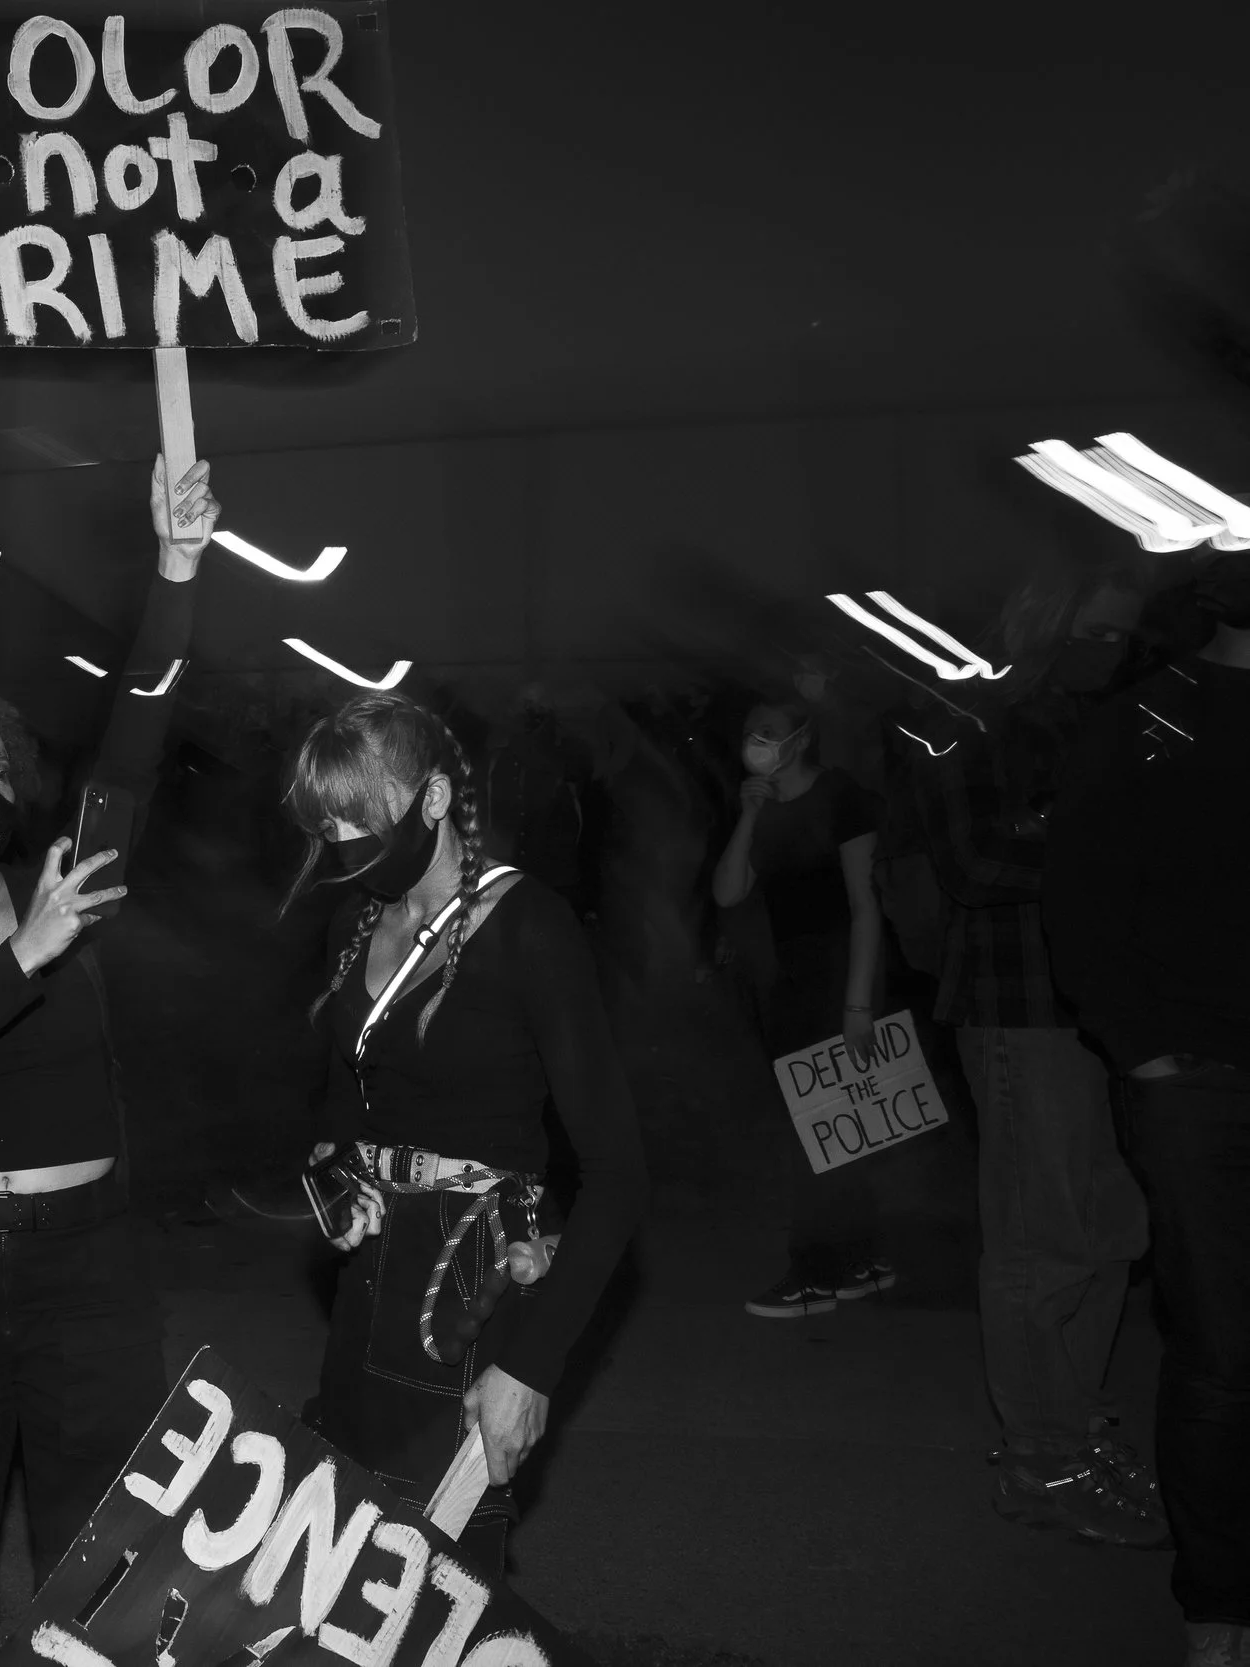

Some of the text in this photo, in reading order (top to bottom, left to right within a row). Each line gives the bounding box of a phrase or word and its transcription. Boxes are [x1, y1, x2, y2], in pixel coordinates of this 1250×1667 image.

[19, 112, 219, 221] not
[273, 149, 366, 236] a
[811, 1082, 939, 1164] POLICE
[840, 1075, 881, 1105] THE
